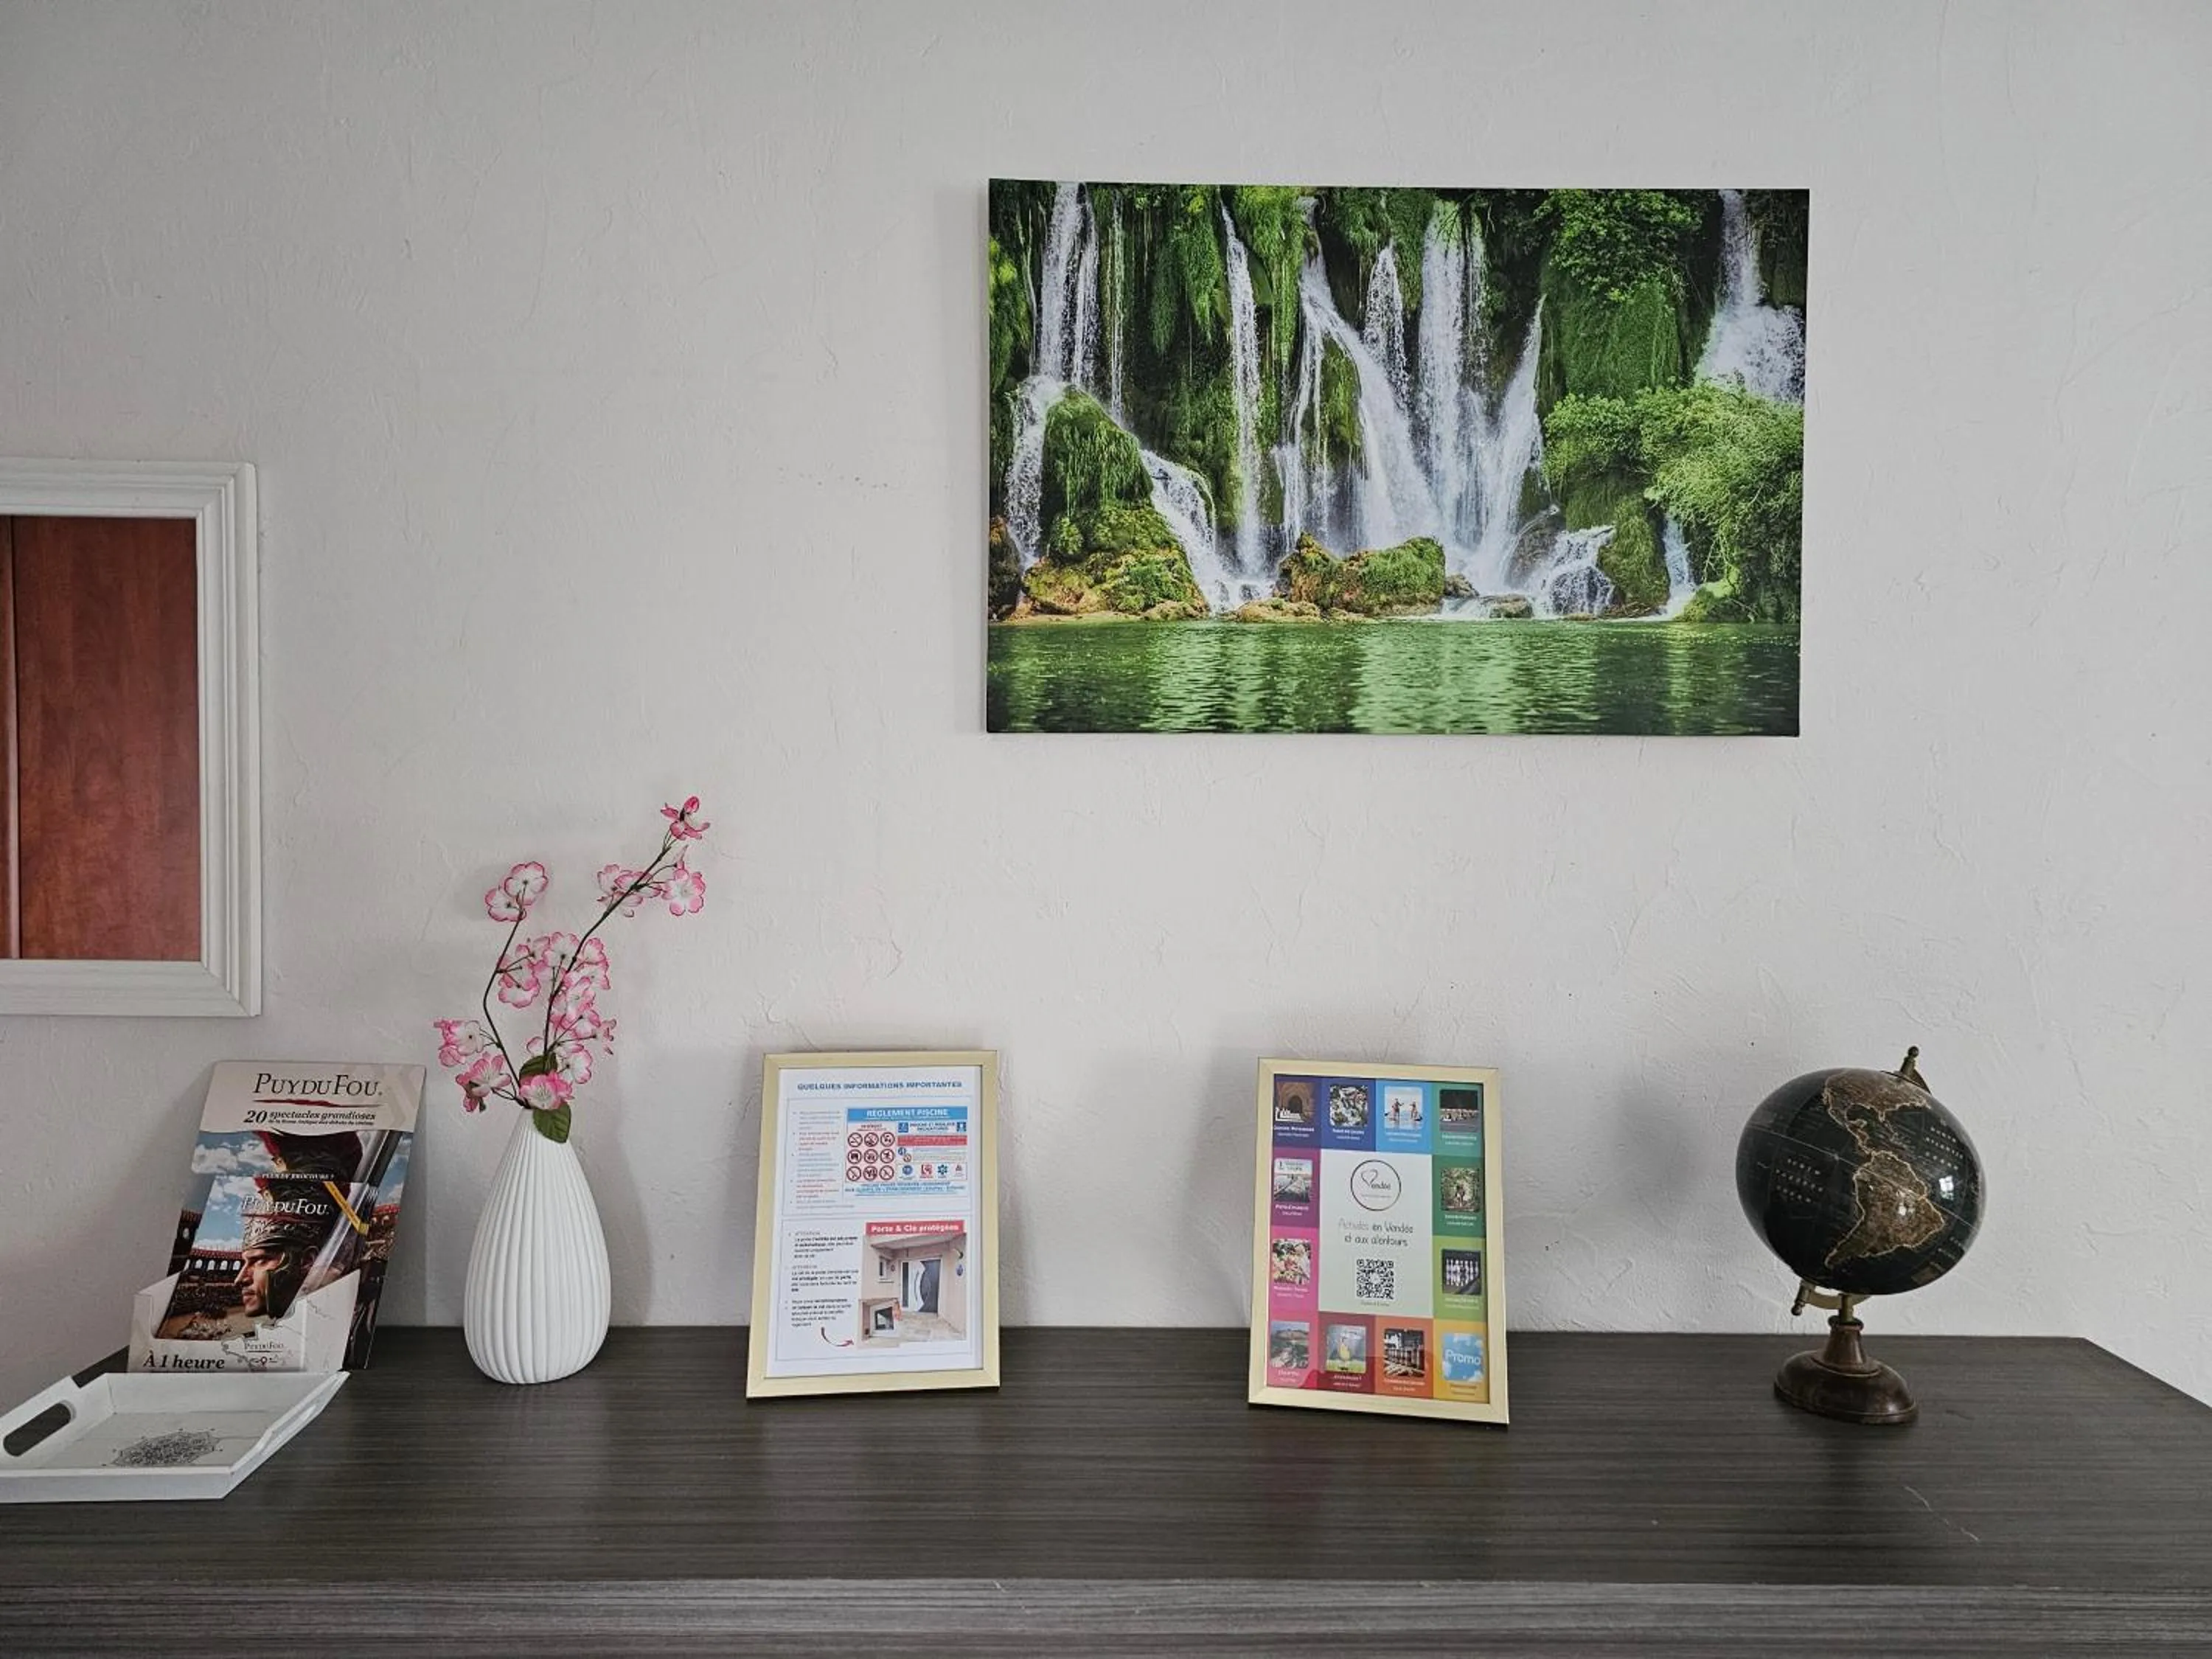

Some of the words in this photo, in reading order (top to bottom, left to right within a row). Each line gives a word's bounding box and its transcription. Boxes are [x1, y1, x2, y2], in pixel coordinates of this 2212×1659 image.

[844, 1082, 904, 1090] INFORMATIONS
[243, 1110, 268, 1124] 20
[268, 1110, 321, 1119] spectacles
[321, 1110, 376, 1121] grandioses
[917, 1107, 949, 1116] PISCINE
[871, 1225, 894, 1233] Porte
[1372, 1223, 1382, 1232] en
[1384, 1220, 1413, 1234] Vendée
[1354, 1236, 1368, 1245] aux
[1371, 1234, 1408, 1247] alentours
[142, 1348, 156, 1368] À
[159, 1354, 168, 1368] 1
[170, 1354, 226, 1370] heure
[1444, 1349, 1481, 1365] Promo
